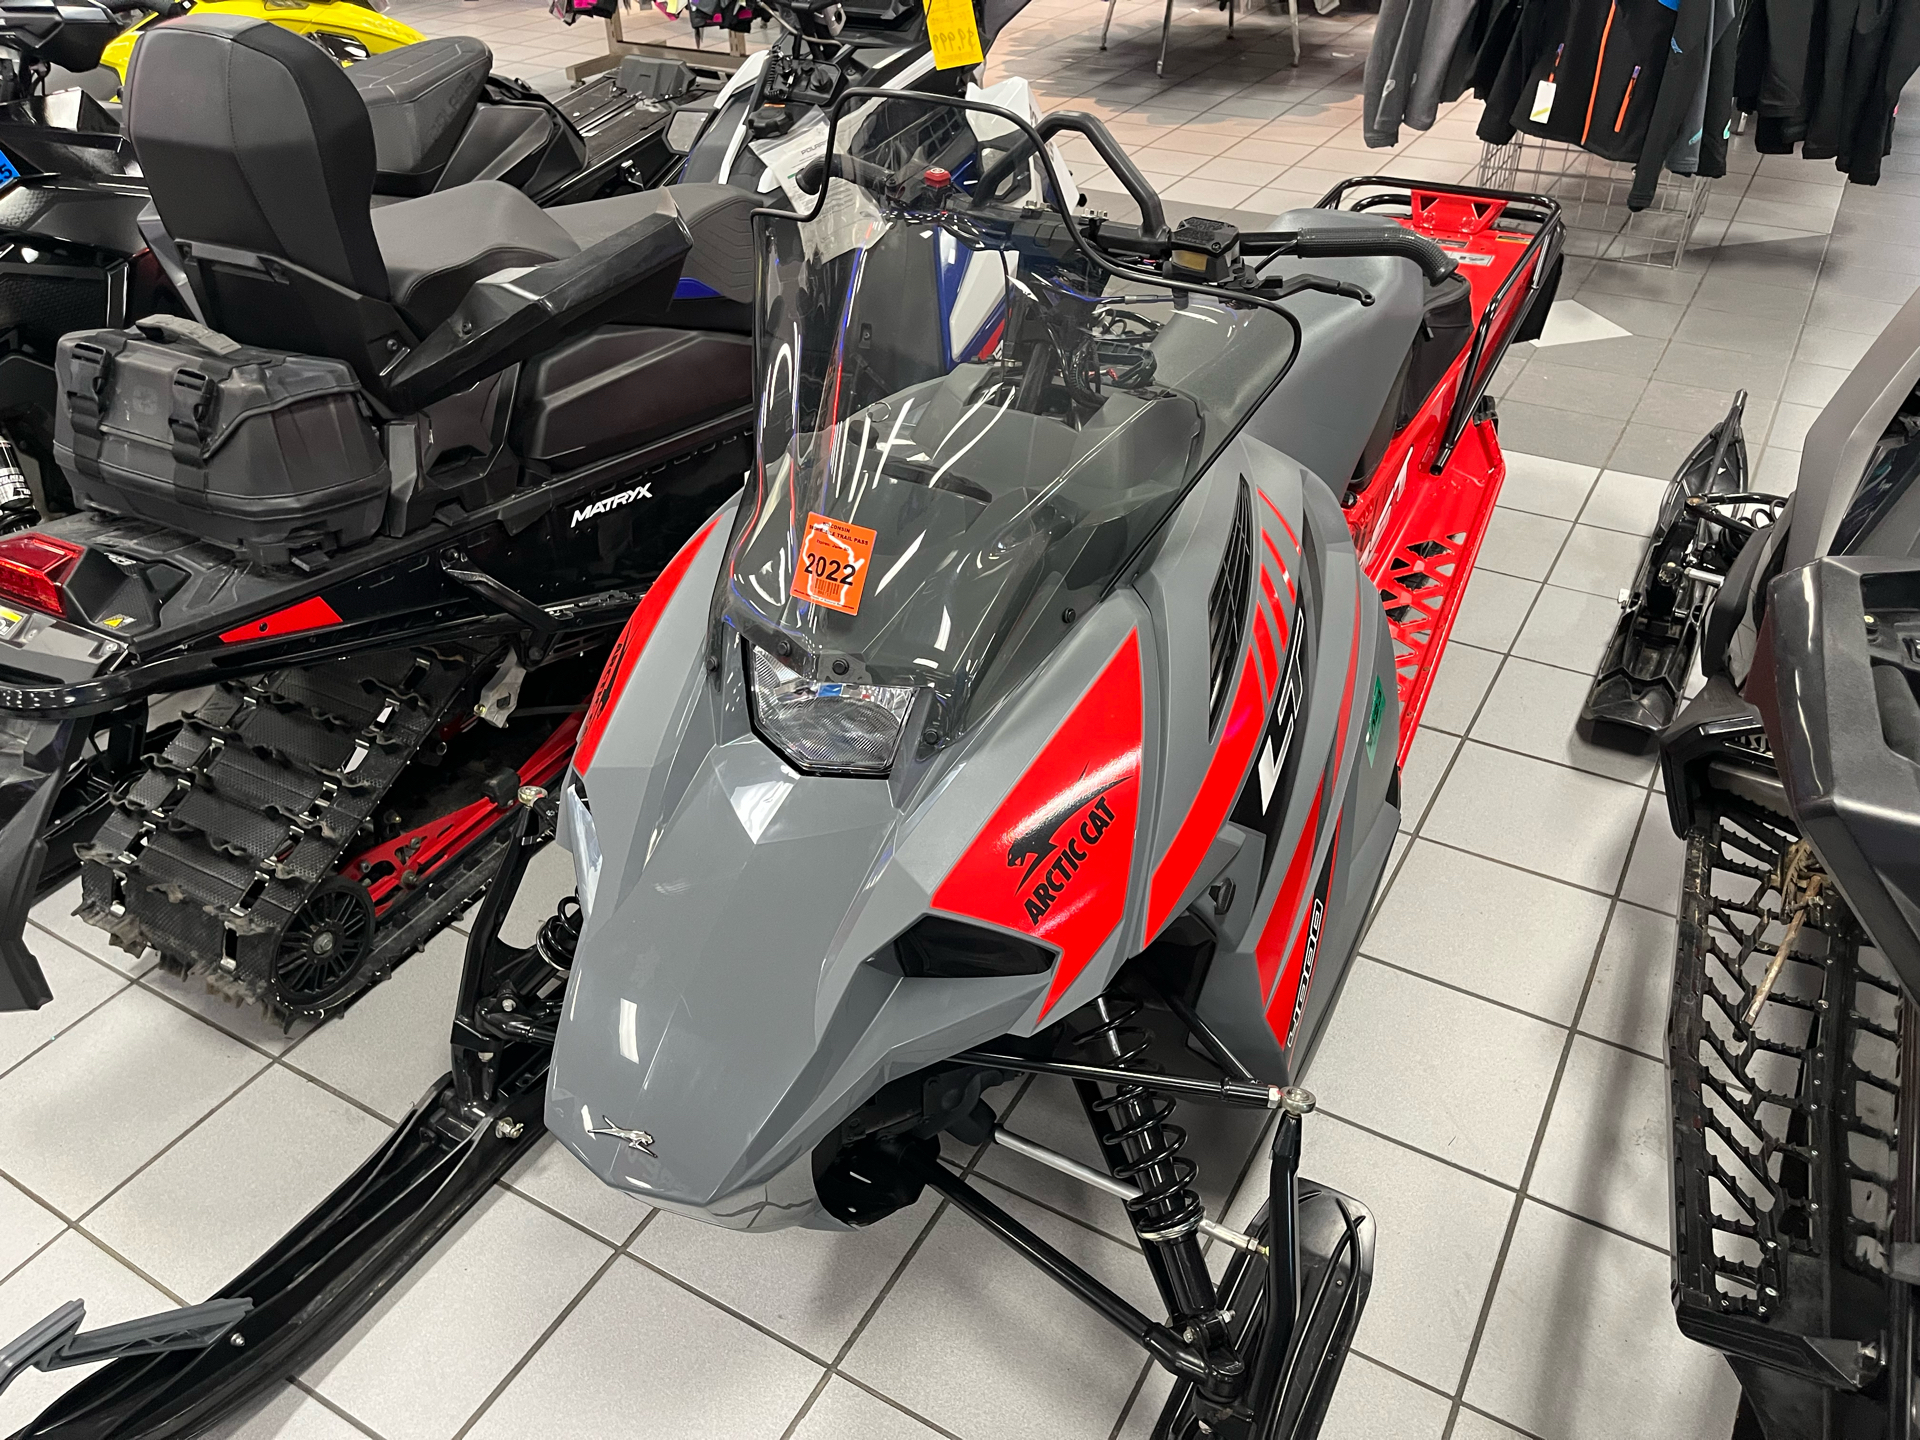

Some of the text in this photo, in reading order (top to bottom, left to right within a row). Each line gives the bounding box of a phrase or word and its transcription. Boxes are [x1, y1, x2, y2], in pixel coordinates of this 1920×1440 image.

[801, 140, 827, 155] POLAR
[570, 482, 653, 528] MATRYX
[853, 537, 869, 546] PASS
[804, 552, 856, 586] 2022
[1023, 795, 1116, 926] ARCTIC CAT
